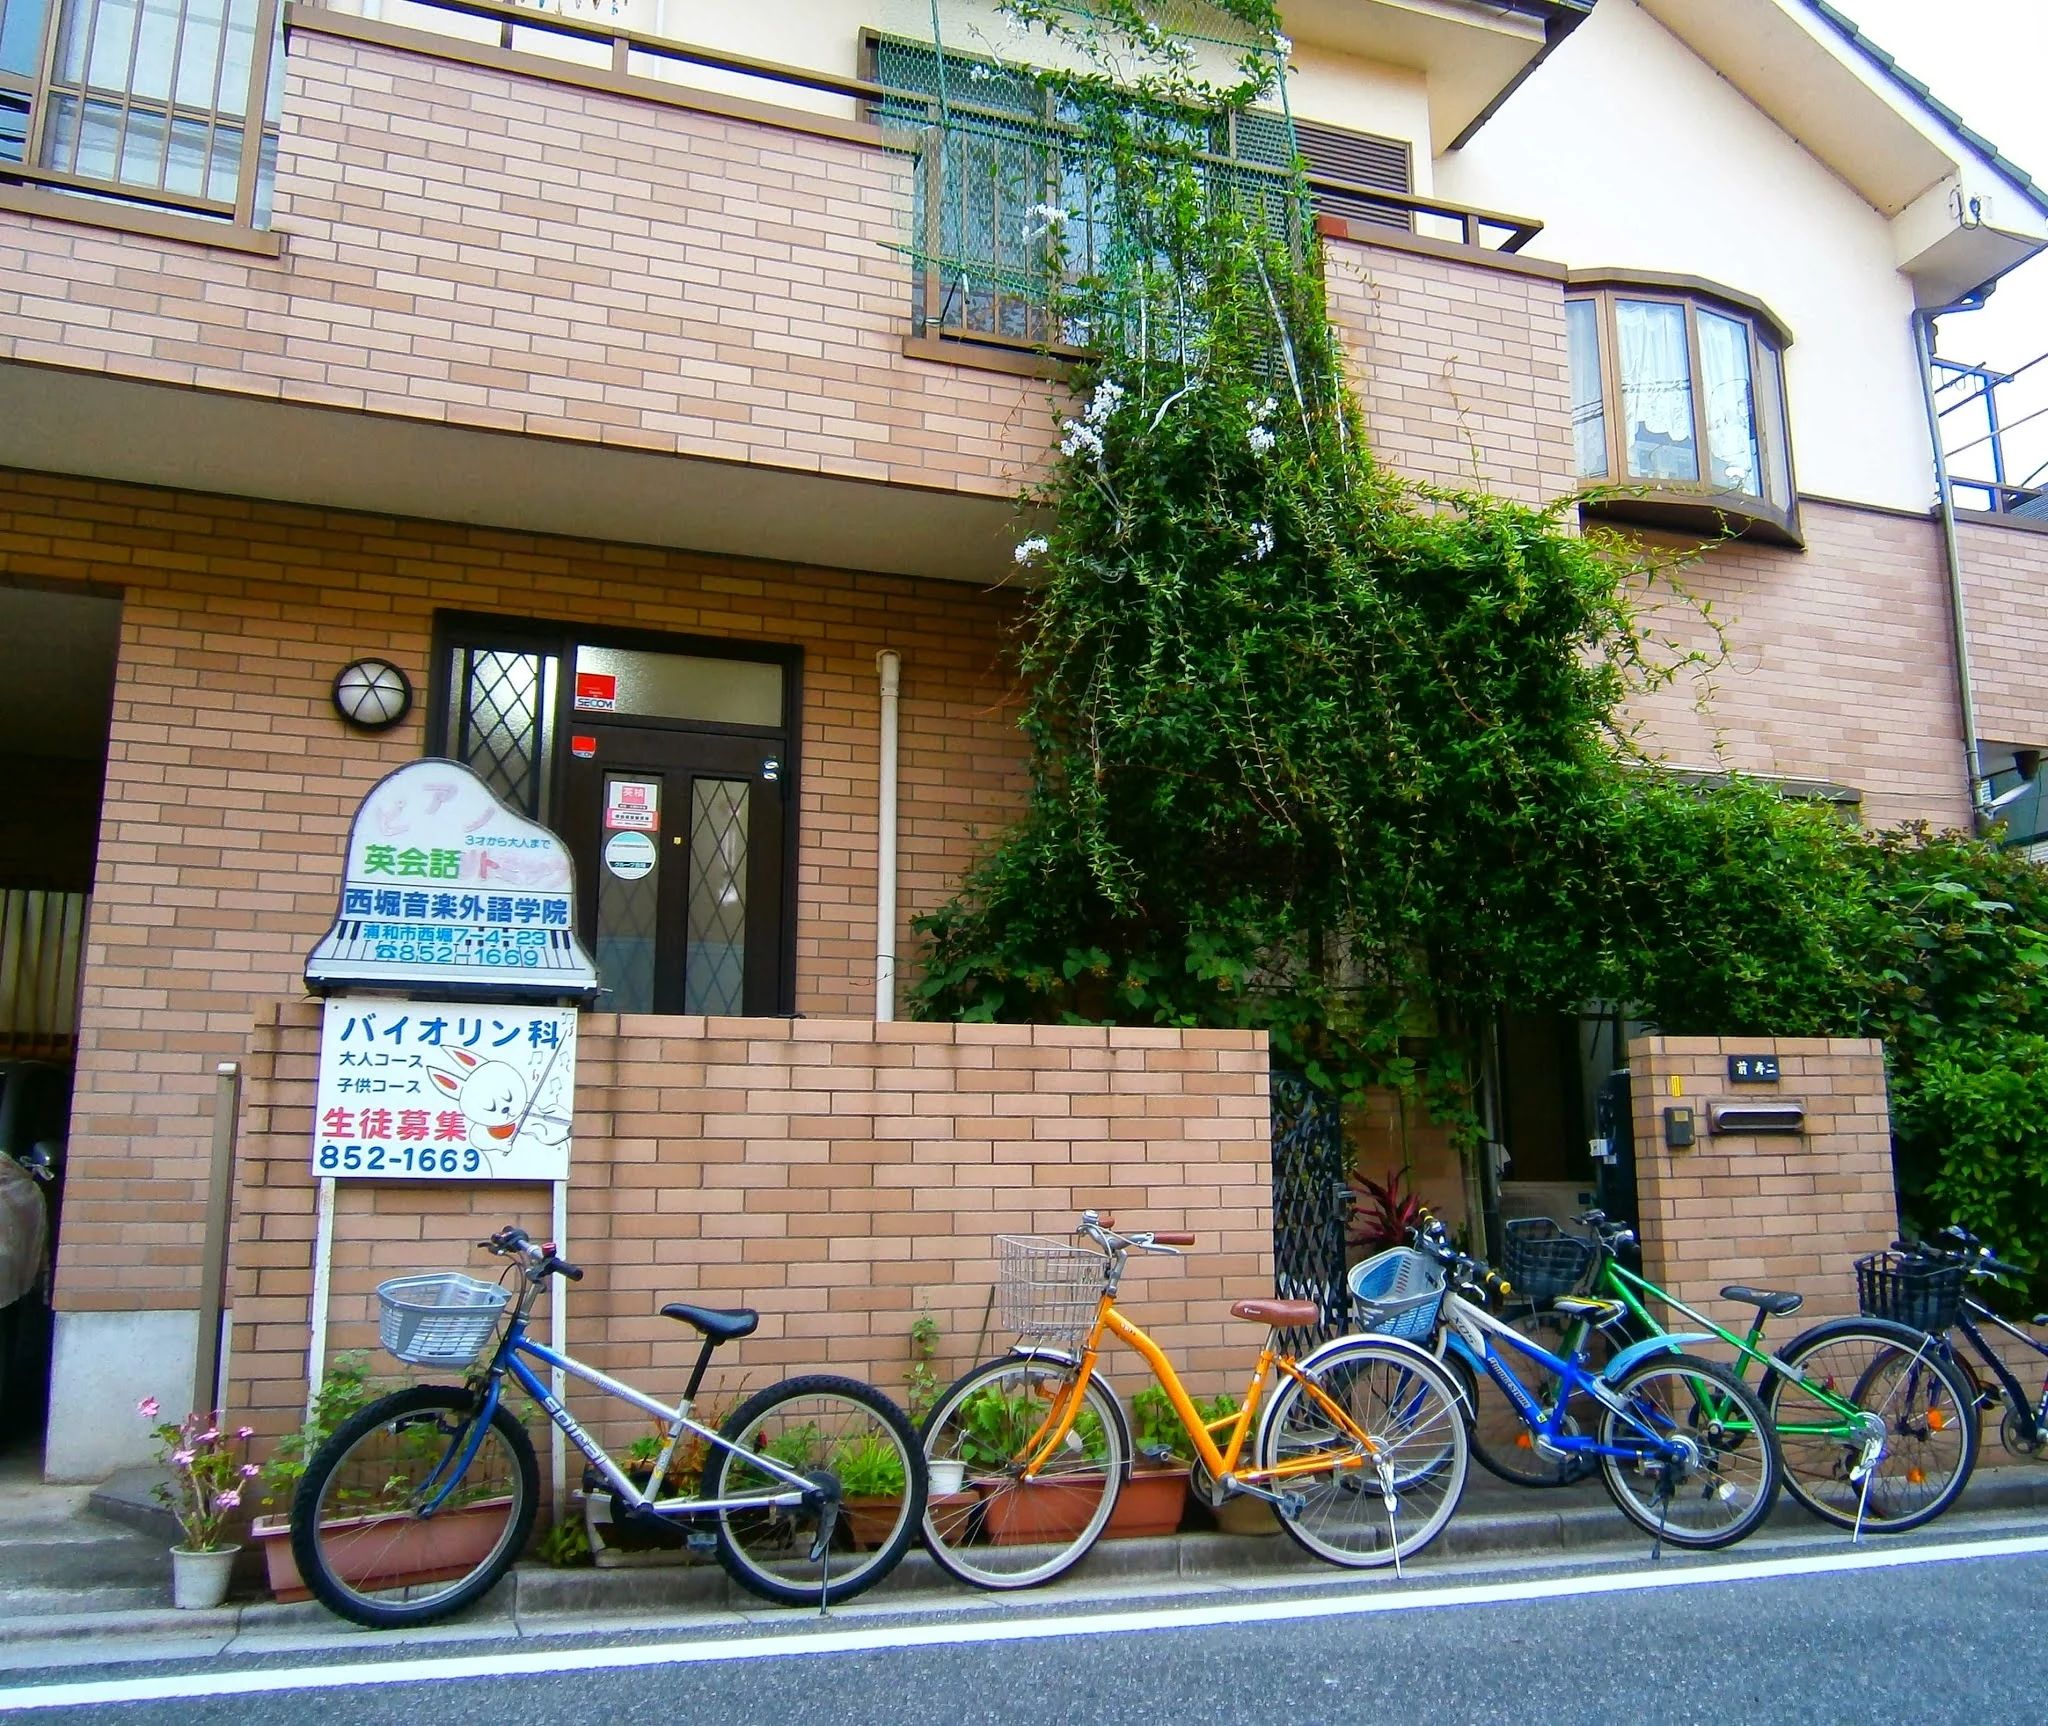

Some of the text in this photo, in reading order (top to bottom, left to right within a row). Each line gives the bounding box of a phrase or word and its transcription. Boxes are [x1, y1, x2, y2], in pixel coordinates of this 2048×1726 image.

[577, 698, 613, 709] SECOM
[464, 834, 551, 850] 3才から大人まで
[363, 844, 463, 880] 英会話
[345, 887, 568, 925] 西堀音楽外語学院
[340, 1013, 560, 1049] バイオリン科
[338, 1051, 424, 1068] 大人コース
[337, 1078, 421, 1094] 子供コース
[321, 1106, 468, 1142] 生徒募集
[319, 1145, 480, 1173] 852-1669
